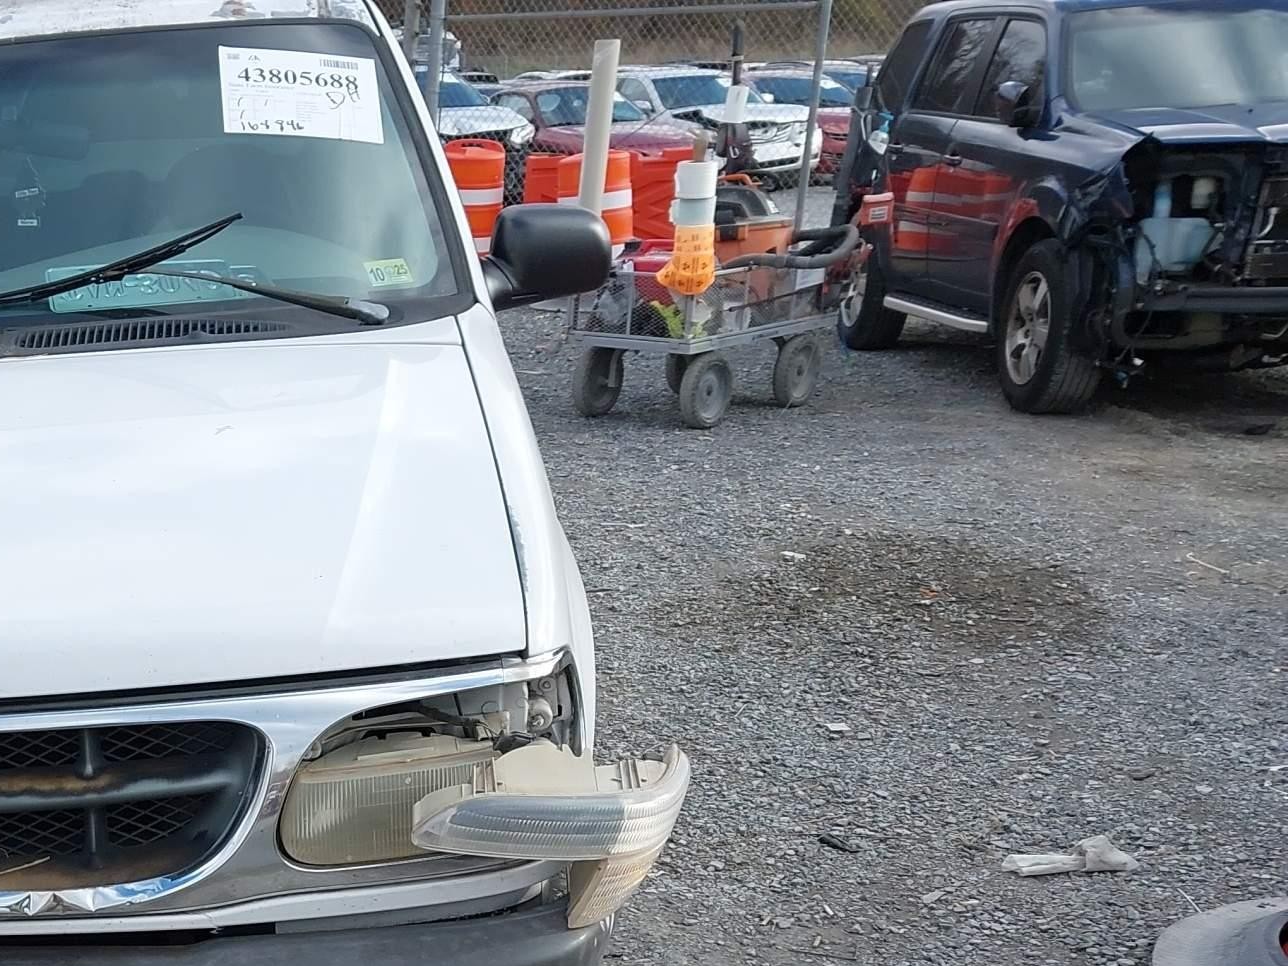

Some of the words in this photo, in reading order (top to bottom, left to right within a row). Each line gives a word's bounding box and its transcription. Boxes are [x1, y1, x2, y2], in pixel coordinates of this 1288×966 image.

[237, 66, 359, 91] 43805688
[368, 267, 385, 282] 10
[393, 263, 409, 275] 25
